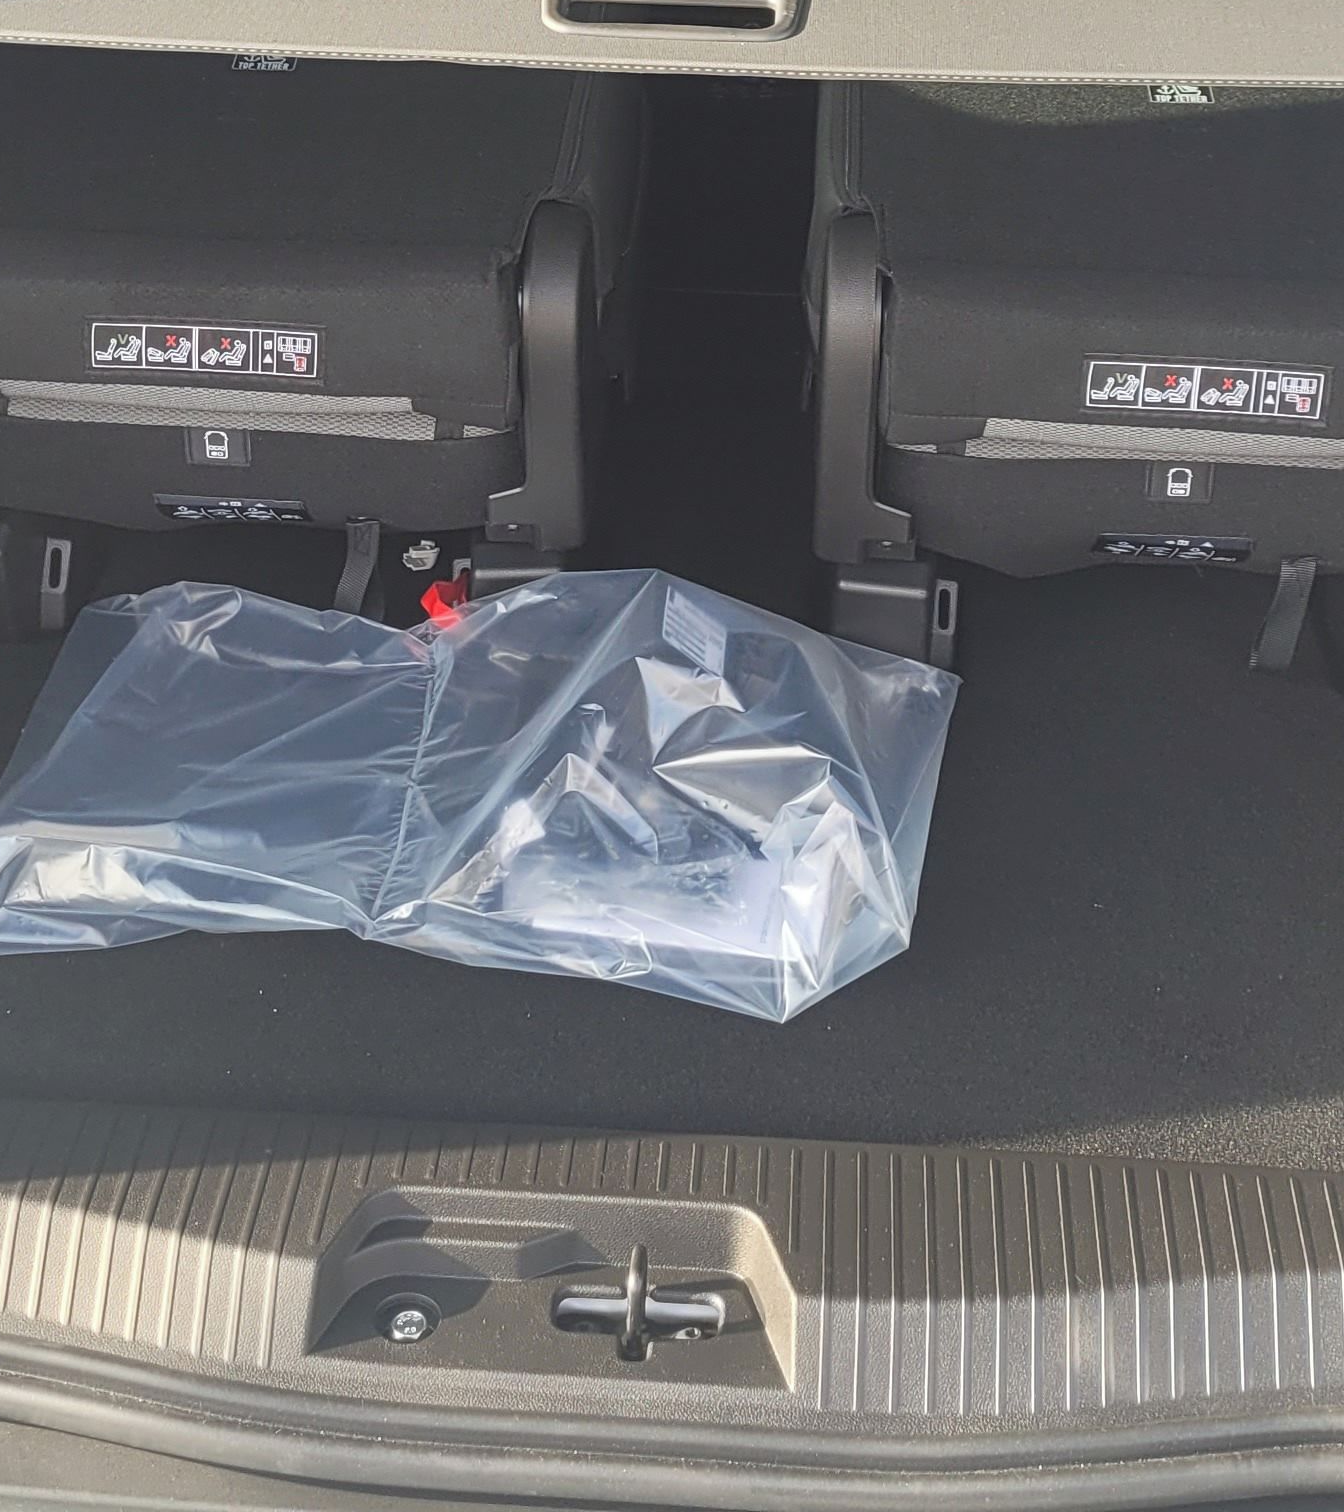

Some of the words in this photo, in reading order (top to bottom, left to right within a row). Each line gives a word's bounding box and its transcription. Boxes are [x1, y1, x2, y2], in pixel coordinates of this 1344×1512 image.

[238, 61, 255, 70] TOP
[257, 62, 290, 71] TETHER
[1154, 94, 1172, 103] TOP
